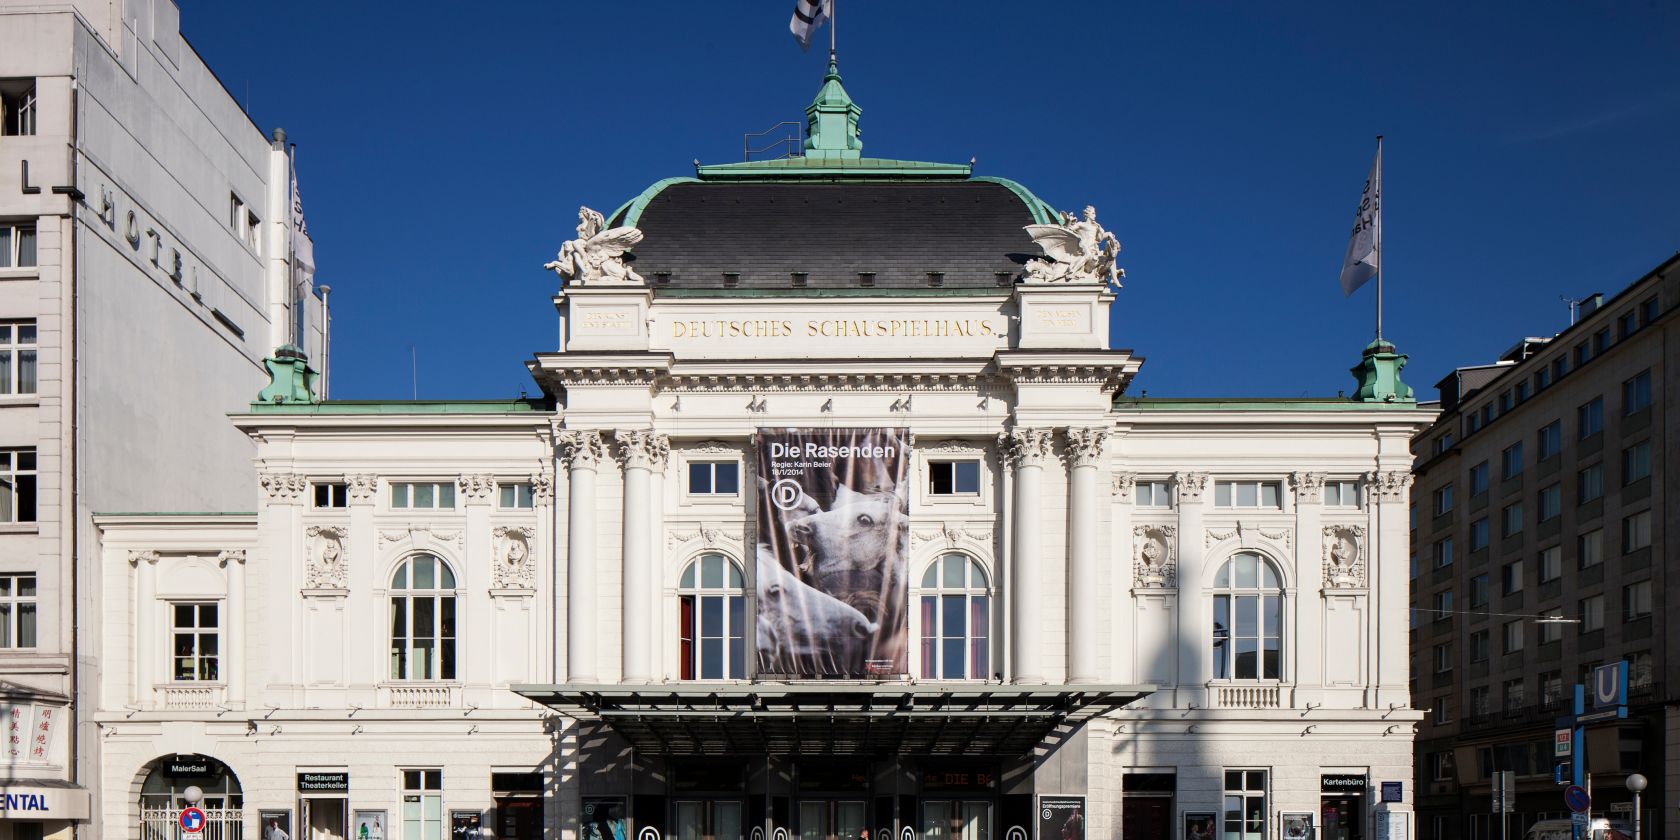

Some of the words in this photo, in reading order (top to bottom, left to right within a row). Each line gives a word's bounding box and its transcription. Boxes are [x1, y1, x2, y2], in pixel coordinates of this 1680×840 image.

[97, 184, 202, 304] HOTEL
[672, 320, 792, 338] DEUTSCHES
[808, 320, 997, 337] SCHAUSPIELHAUS.
[772, 442, 800, 458] Die
[806, 442, 895, 458] Rasenden
[1598, 666, 1617, 702] U
[945, 773, 969, 784] DIE
